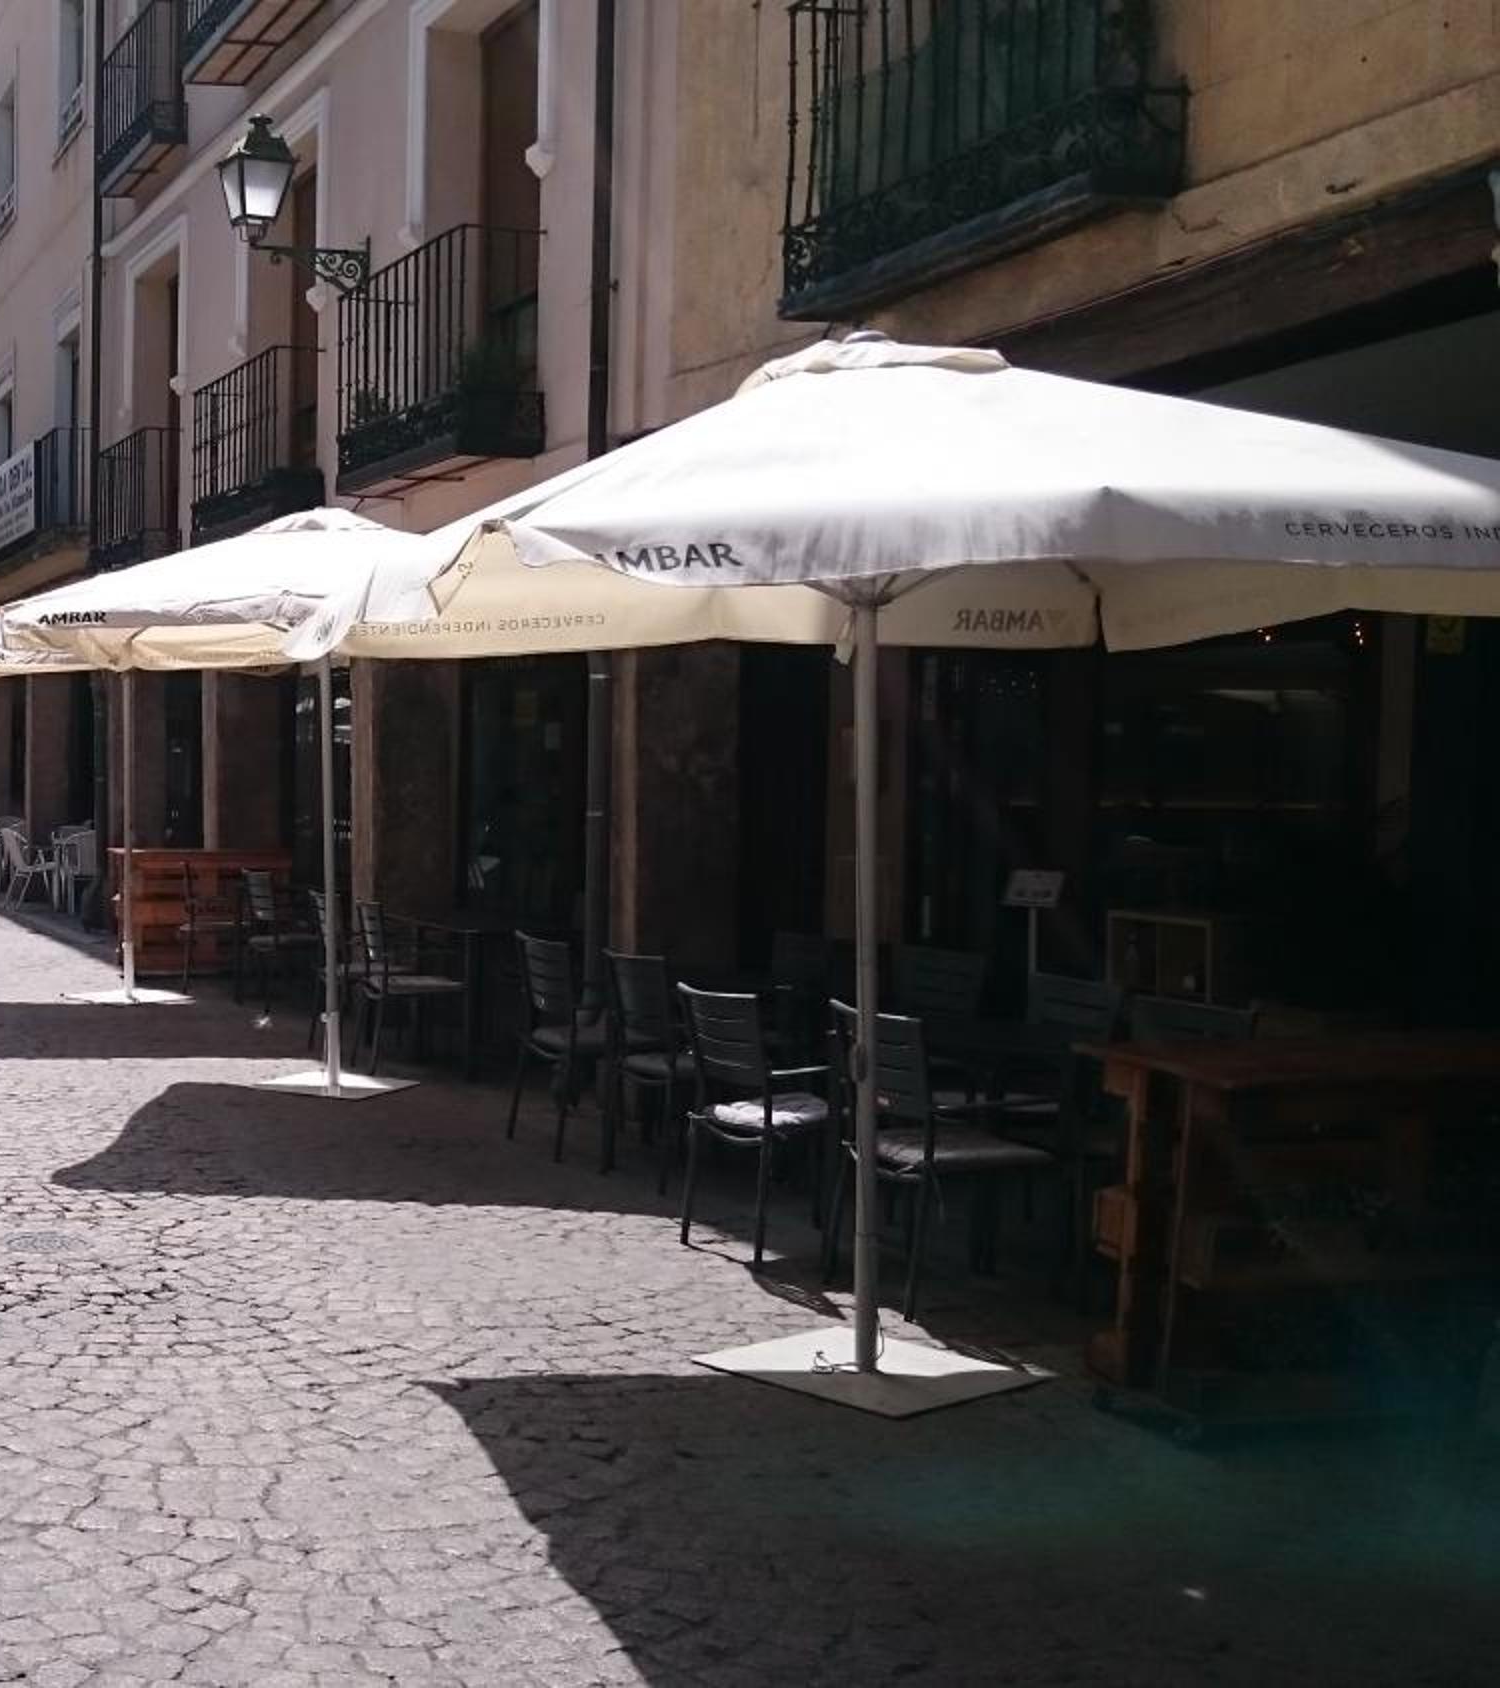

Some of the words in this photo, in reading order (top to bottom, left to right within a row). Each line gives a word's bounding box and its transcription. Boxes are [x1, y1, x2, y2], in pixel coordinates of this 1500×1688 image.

[1285, 522, 1453, 540] CERVECEROS
[595, 542, 745, 572] MBAR
[38, 611, 108, 625] AMBAR
